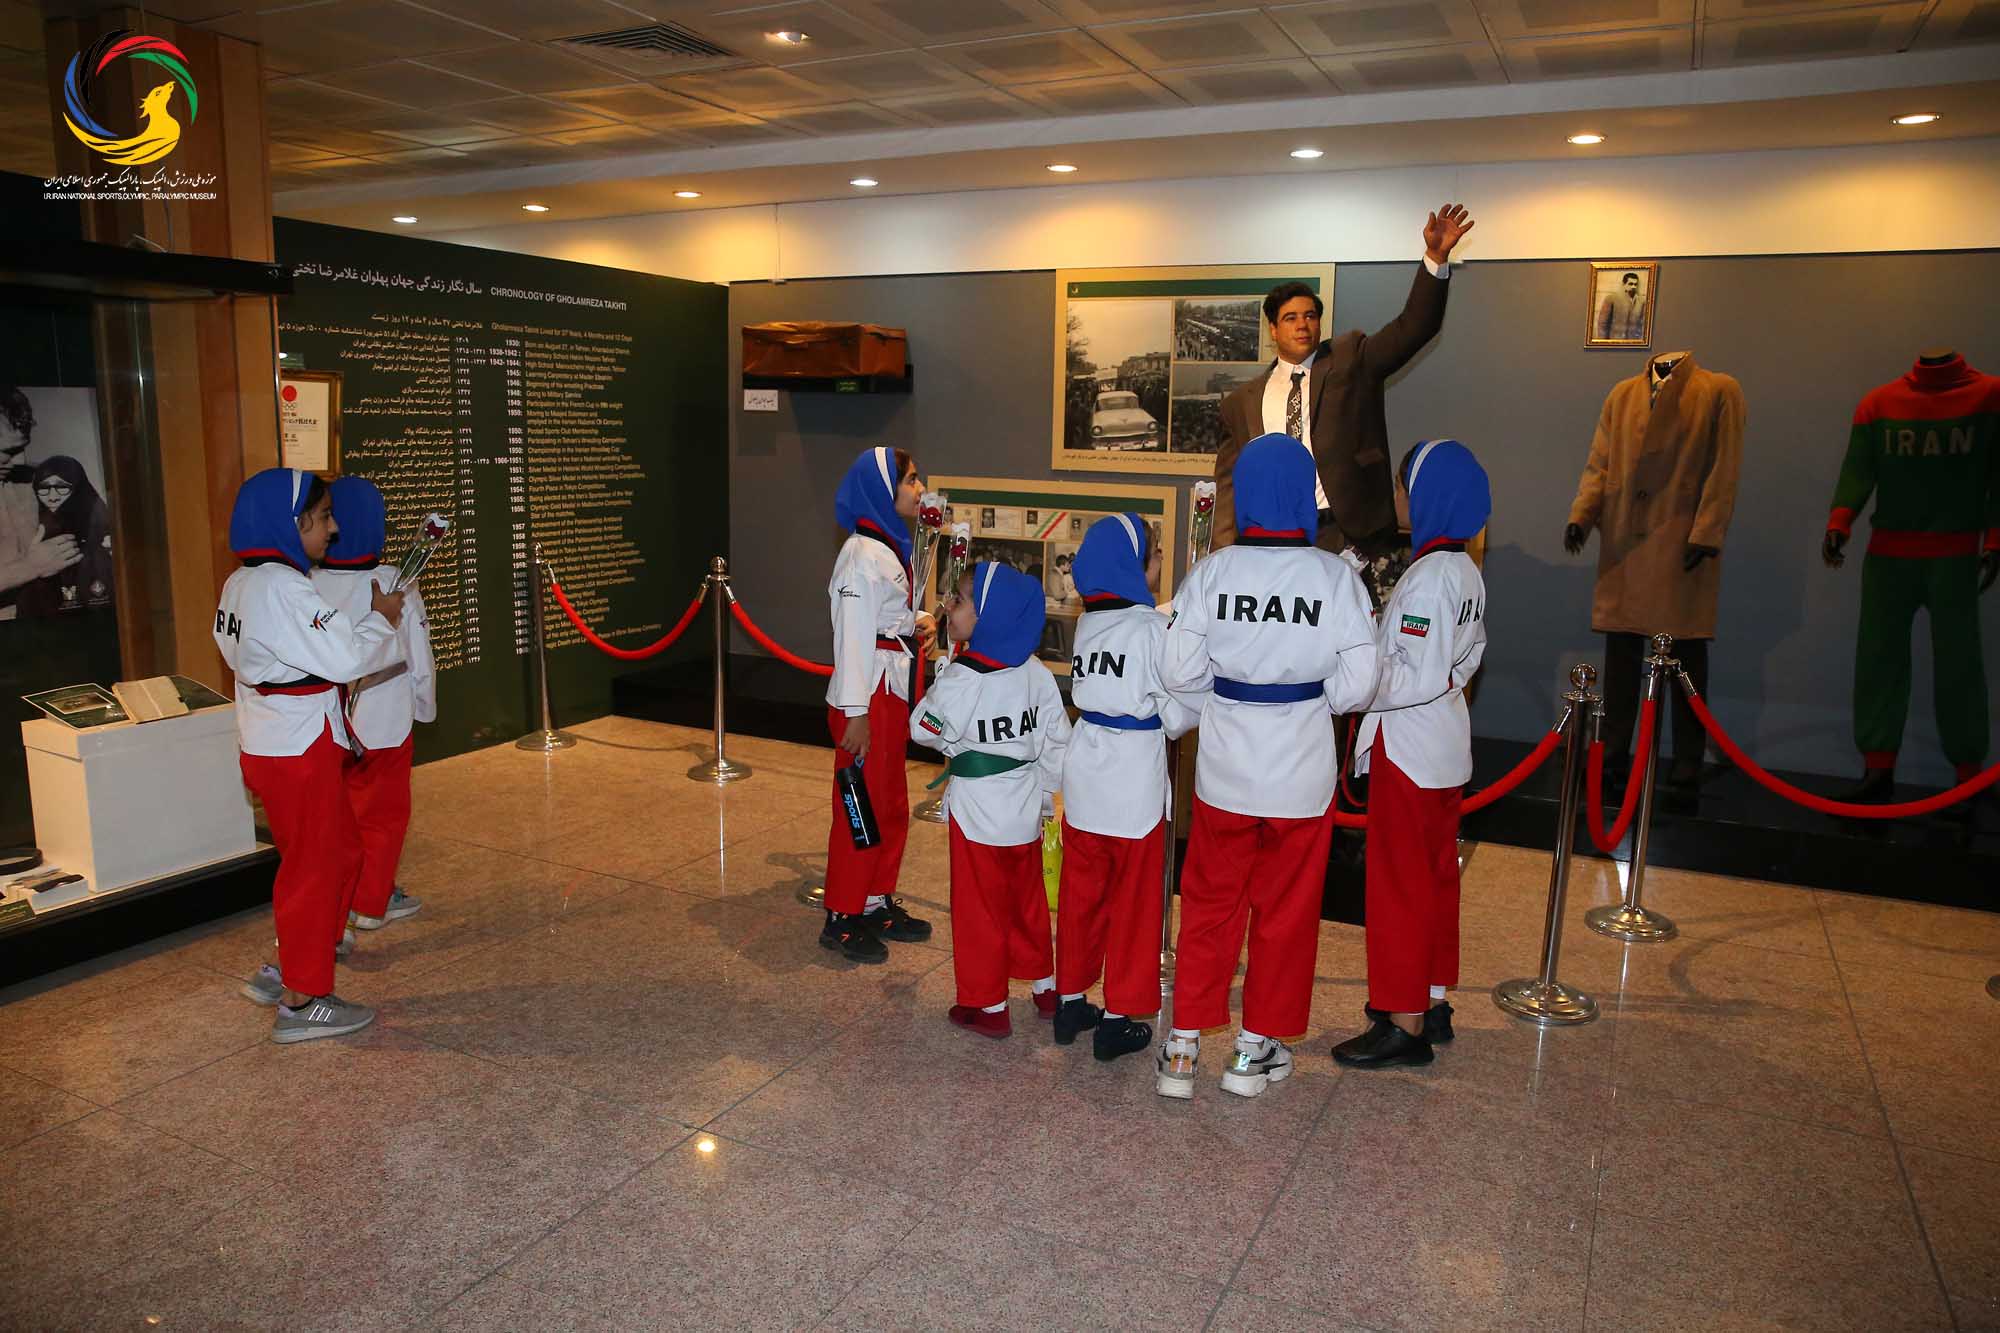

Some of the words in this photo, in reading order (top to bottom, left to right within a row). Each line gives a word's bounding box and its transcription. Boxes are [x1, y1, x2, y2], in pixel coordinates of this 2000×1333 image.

[293, 262, 317, 277] تختی
[319, 264, 358, 282] غلامرضا
[361, 269, 389, 287] پهلوان
[391, 274, 414, 287] جهان
[416, 275, 445, 292] زندگی
[465, 281, 482, 294] سال
[490, 286, 543, 301] CHRONOLOGY
[545, 293, 556, 302] OF
[556, 294, 604, 308] GHOLAMREZA
[604, 299, 627, 311] TAKHTI
[1883, 425, 1976, 457] IRAN
[1217, 593, 1322, 627] IRAN
[1405, 621, 1425, 631] IRAN
